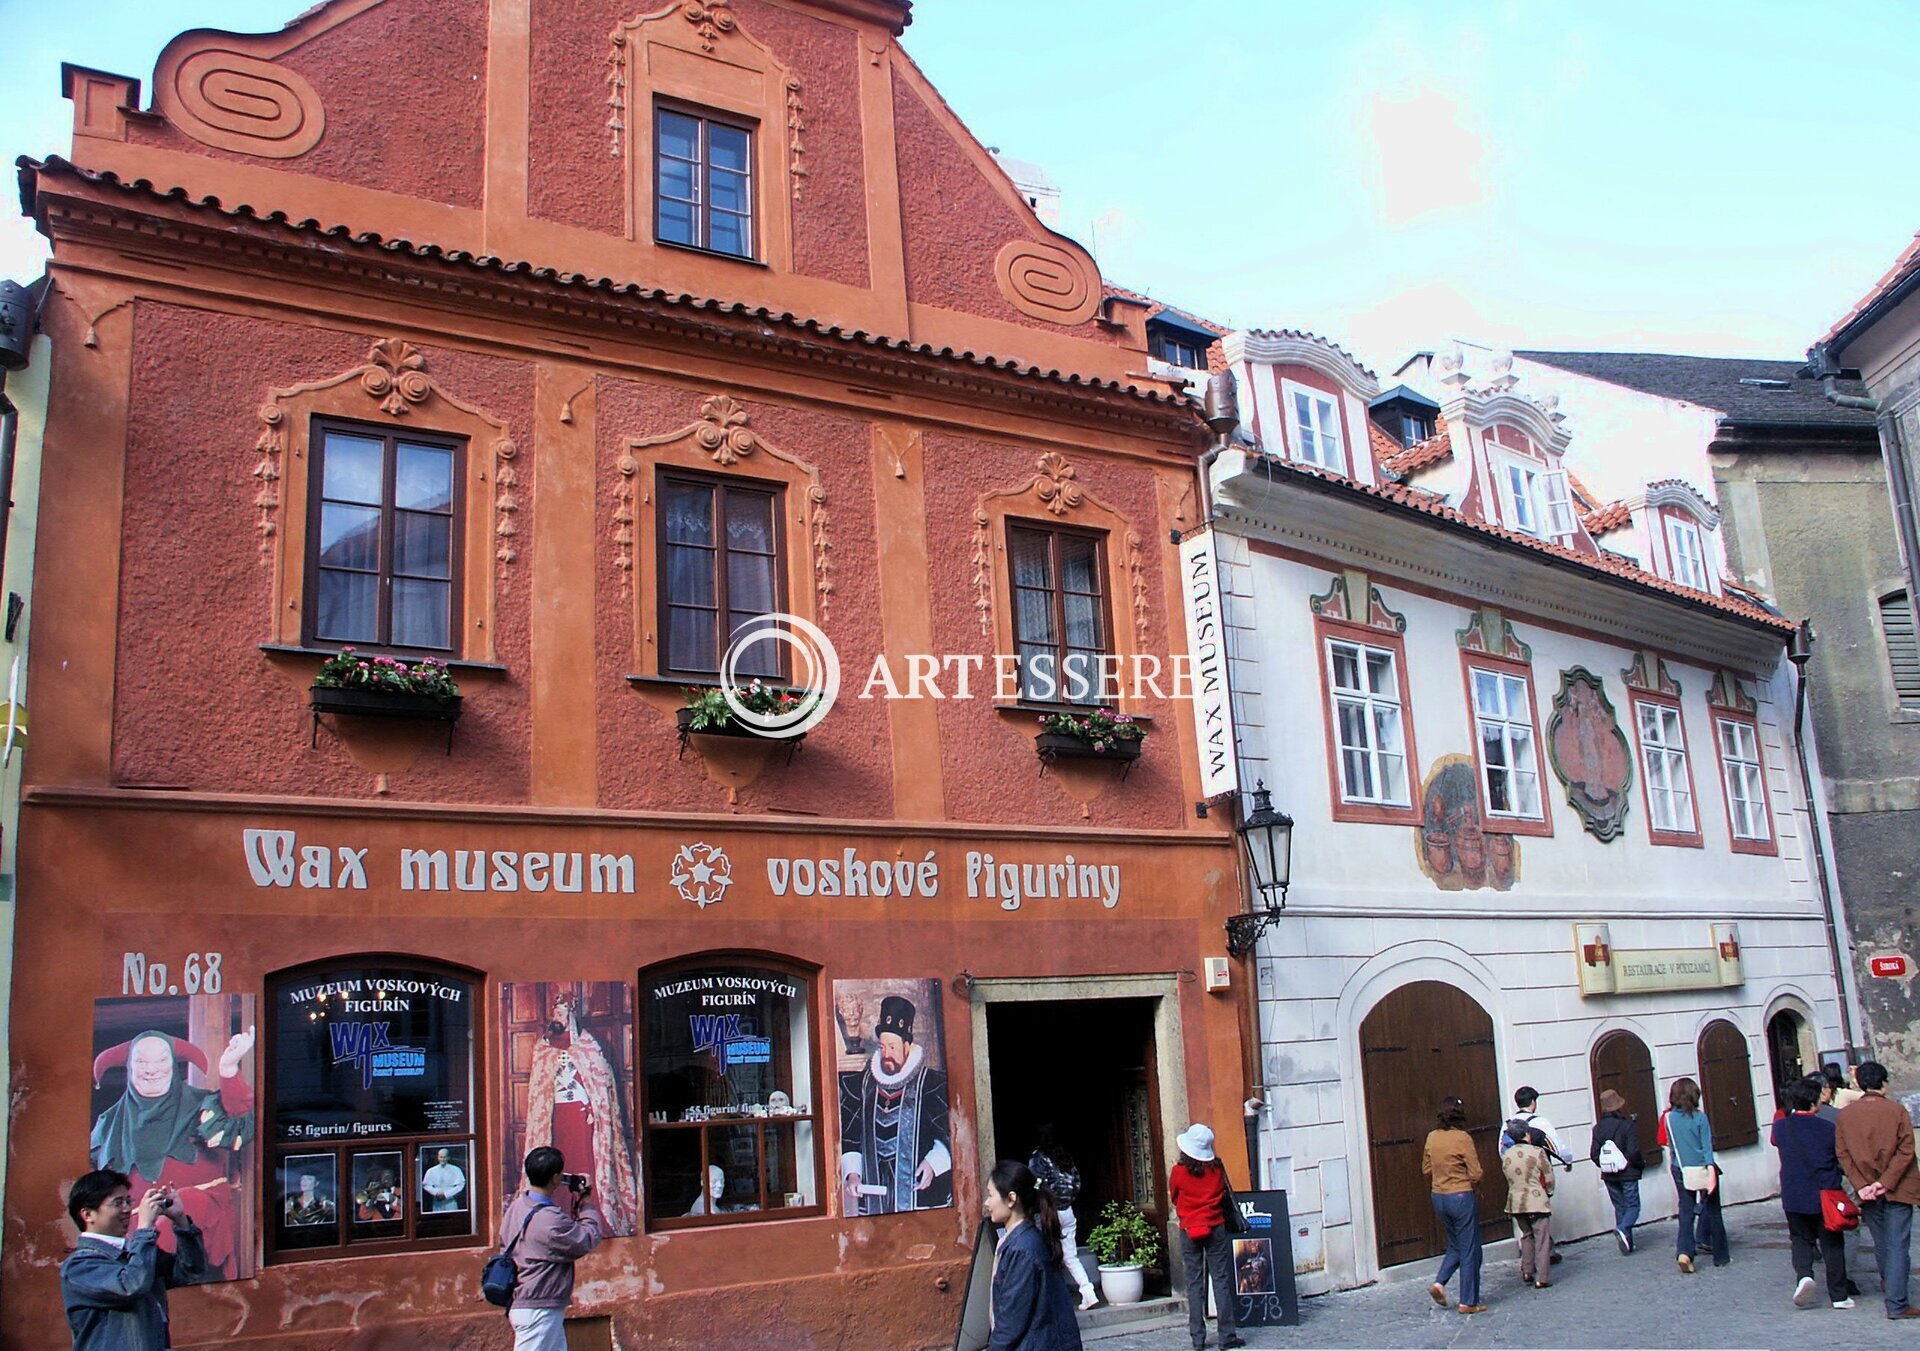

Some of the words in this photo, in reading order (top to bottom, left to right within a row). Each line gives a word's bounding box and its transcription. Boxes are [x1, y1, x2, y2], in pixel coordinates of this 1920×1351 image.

[1191, 550, 1220, 695] MUSEUM
[1206, 704, 1226, 778] WAX
[243, 828, 369, 888] Wax
[400, 849, 636, 893] museum
[767, 848, 938, 897] voskové
[290, 979, 361, 1004] MUZEUM
[365, 979, 462, 1002] VOSKOVÝCH
[654, 978, 713, 999] MUZEUM
[716, 977, 797, 998] VOSKOVÝCH
[702, 991, 756, 1006] FIGURÍN
[344, 997, 410, 1013] FIGURÍN
[329, 1021, 391, 1090] WAX
[689, 1014, 741, 1076] WAX
[726, 1042, 771, 1055] MUSEUM
[372, 1053, 425, 1067] MUSEUM
[288, 1124, 303, 1137] 55
[353, 1122, 392, 1135] figures
